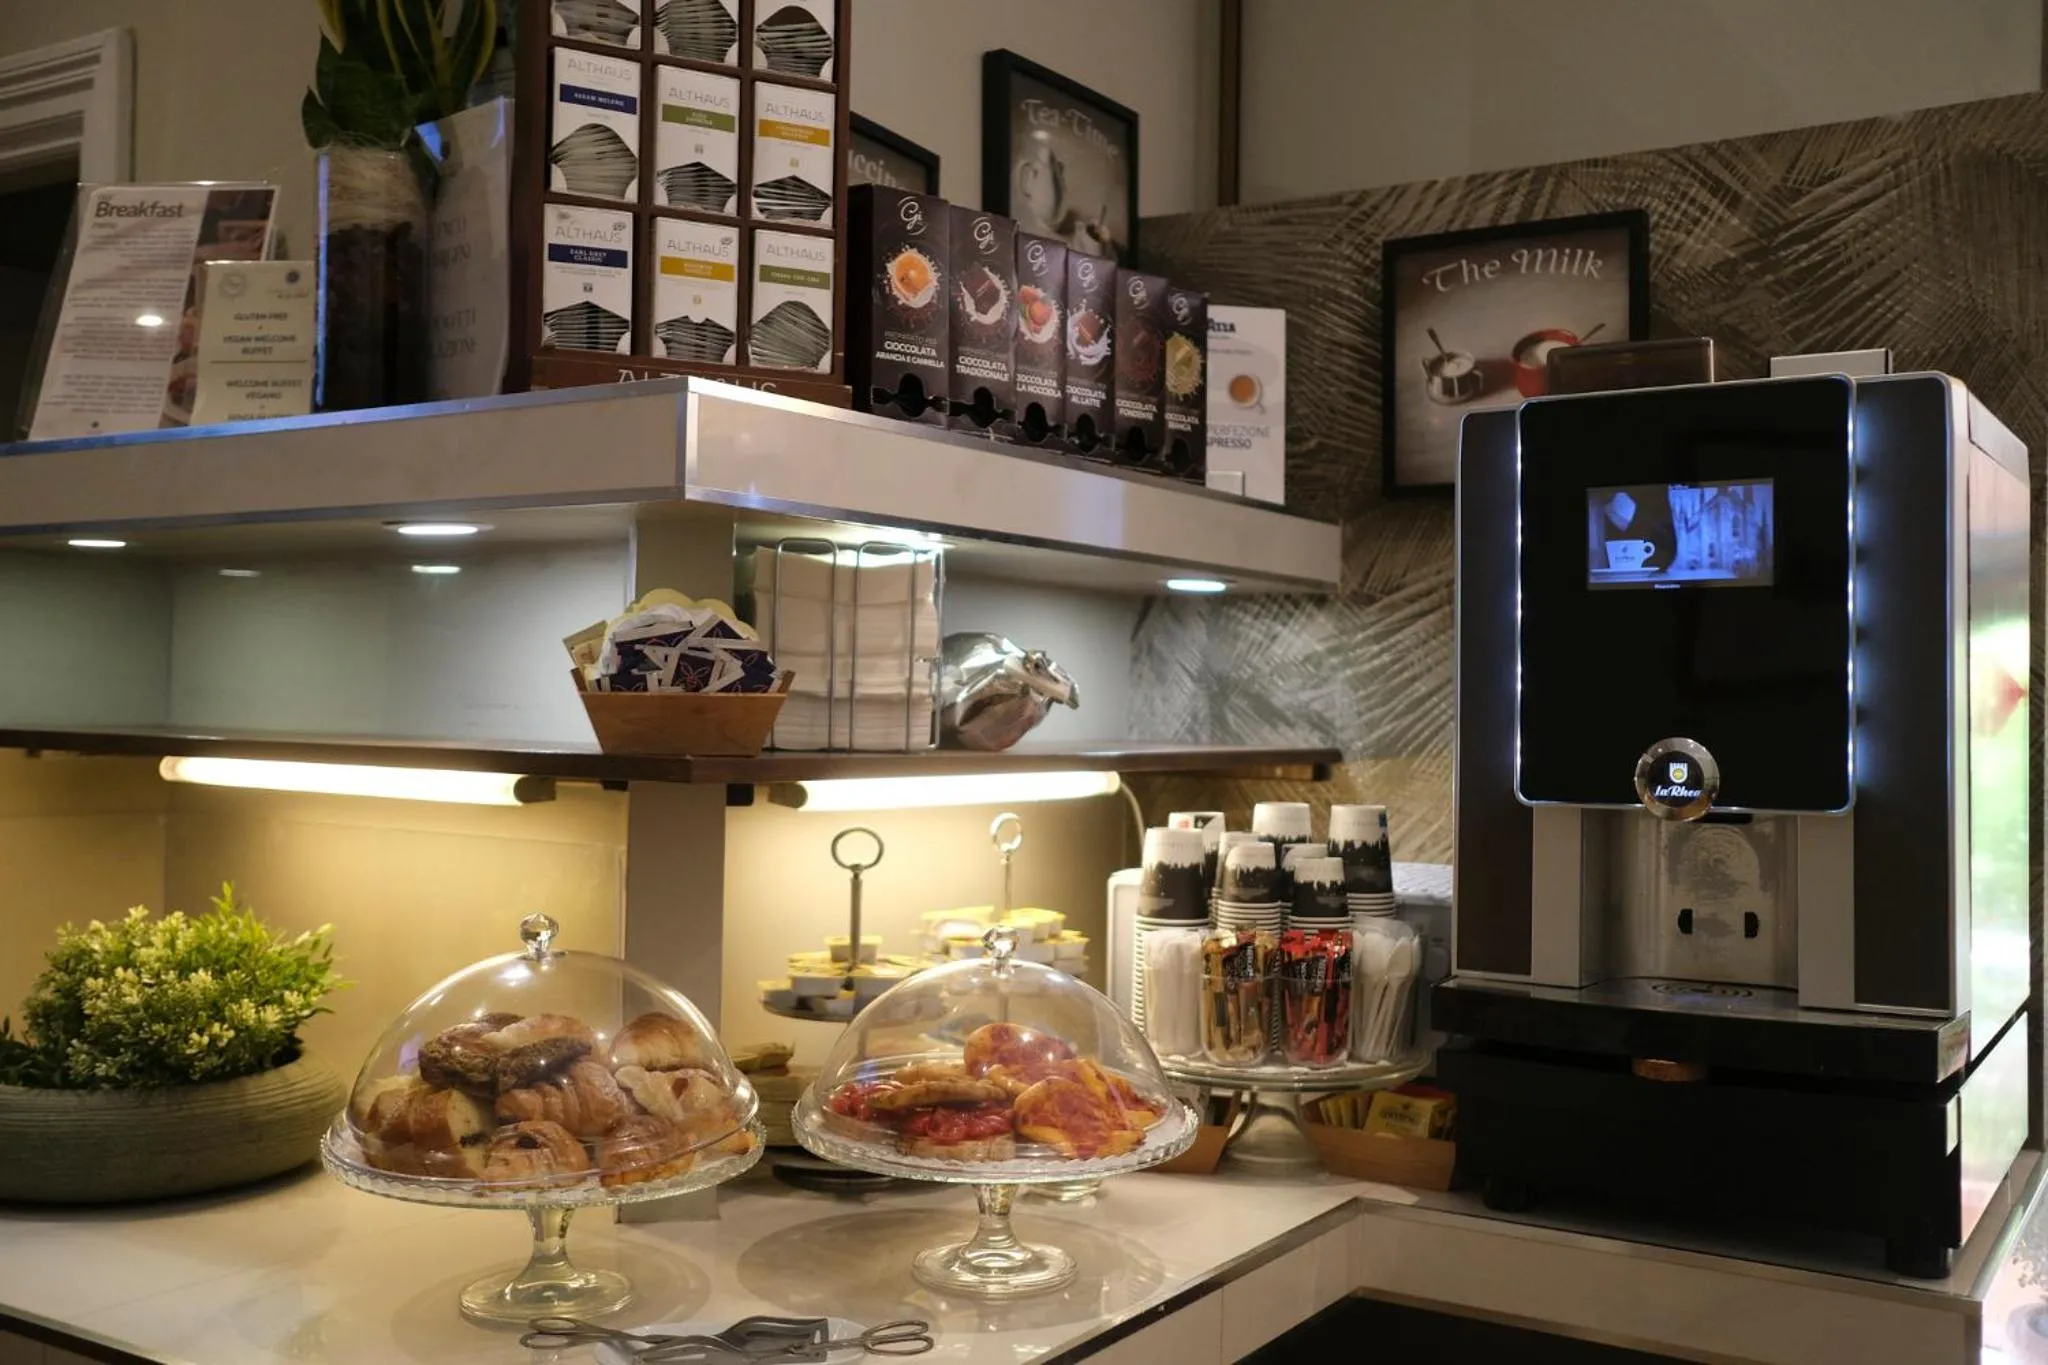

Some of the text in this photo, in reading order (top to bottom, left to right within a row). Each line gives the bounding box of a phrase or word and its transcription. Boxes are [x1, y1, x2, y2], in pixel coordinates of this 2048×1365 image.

[567, 58, 633, 81] ALTHAUS
[668, 87, 731, 108] ALTHAUS
[764, 102, 826, 122] ALTHAUS
[95, 200, 184, 218] Breakfast
[555, 225, 622, 243] ALTHAUS
[667, 239, 729, 257] ALTHAUS
[766, 242, 826, 261] ALTHAUS
[1421, 247, 1603, 292] The Milk
[1207, 317, 1236, 333] AZZA
[884, 340, 938, 357] CIOCCOLATA
[958, 355, 1007, 372] CIOCCOLATA
[1207, 436, 1252, 450] SPRESSO
